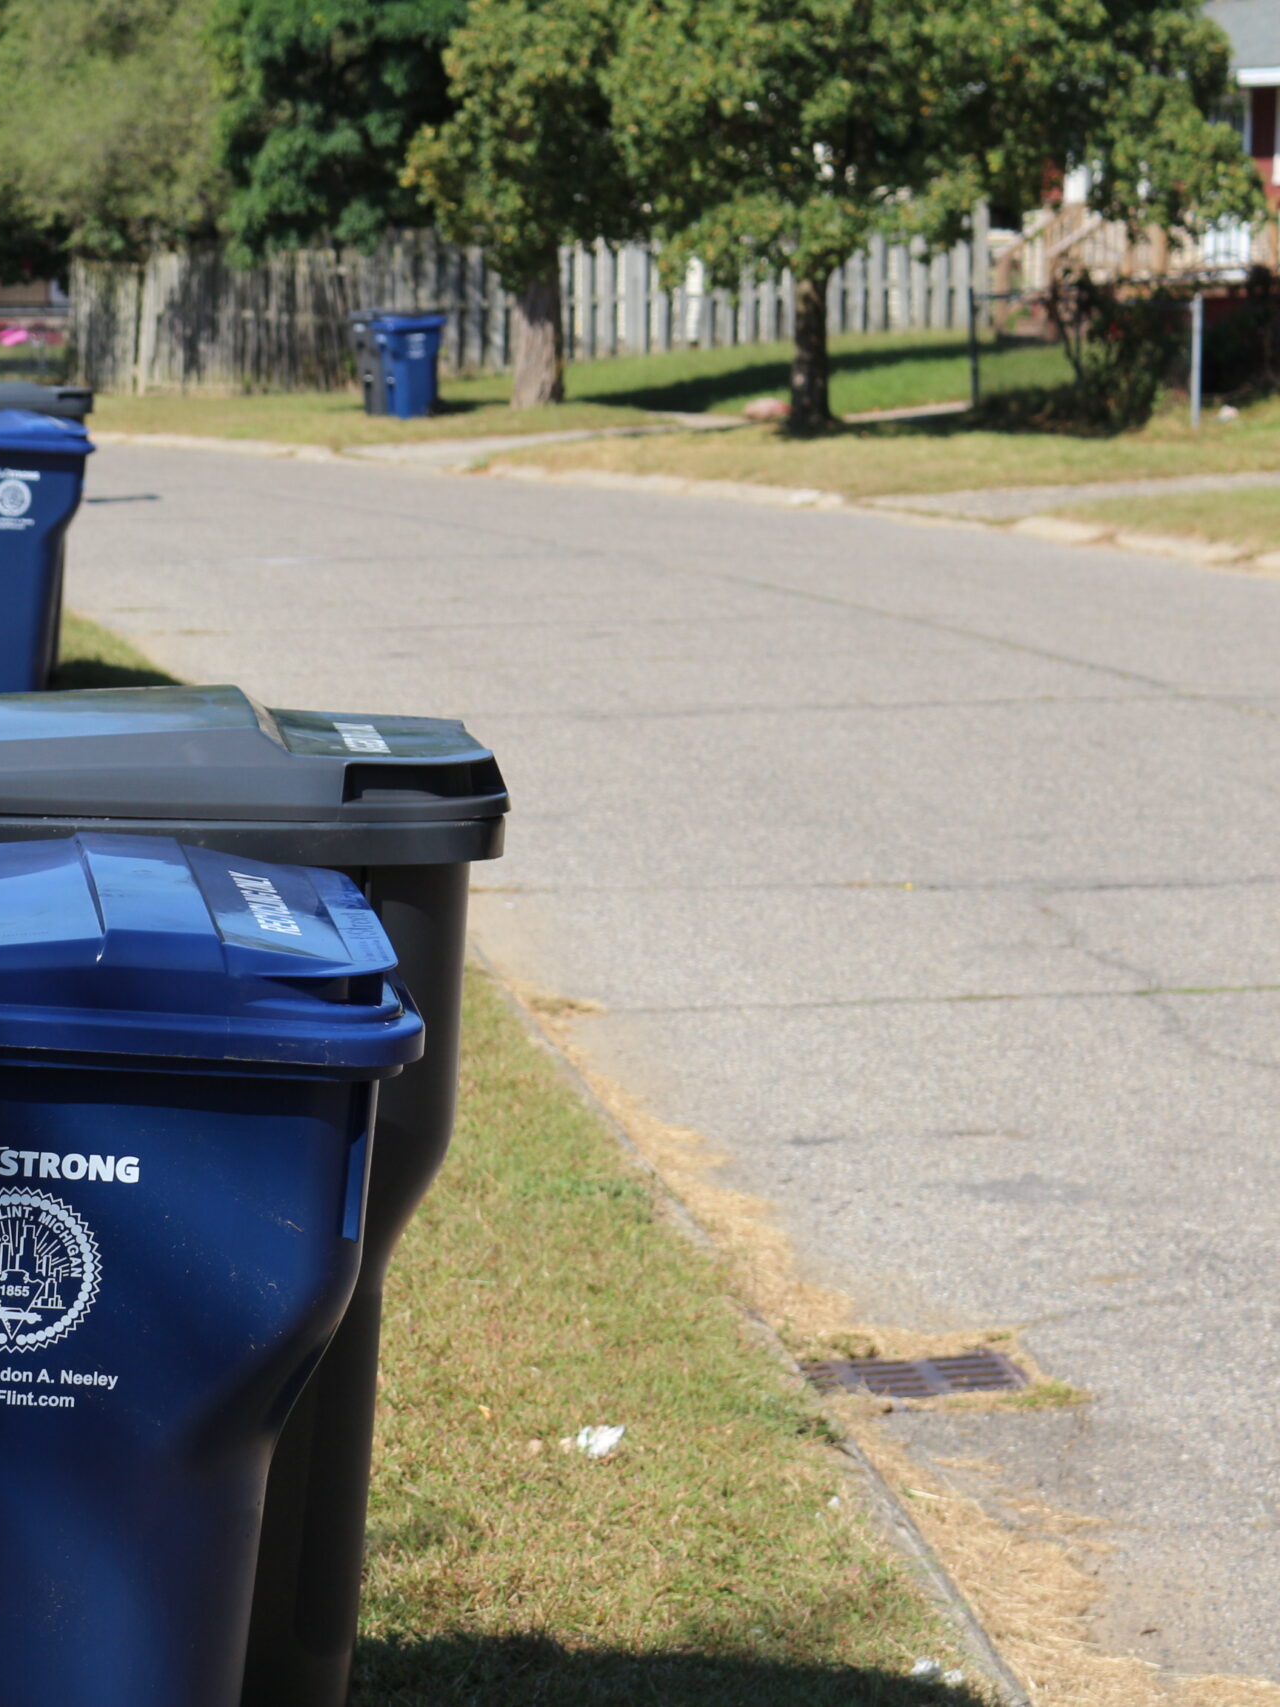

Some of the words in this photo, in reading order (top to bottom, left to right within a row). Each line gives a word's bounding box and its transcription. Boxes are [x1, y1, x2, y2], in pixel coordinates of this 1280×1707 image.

[228, 870, 278, 894] ONLY
[239, 888, 303, 936] RECYCLING
[38, 1211, 83, 1278] MICHIGAN
[0, 1285, 30, 1297] 1855
[37, 1368, 55, 1384] A.
[61, 1370, 119, 1389] Neeley
